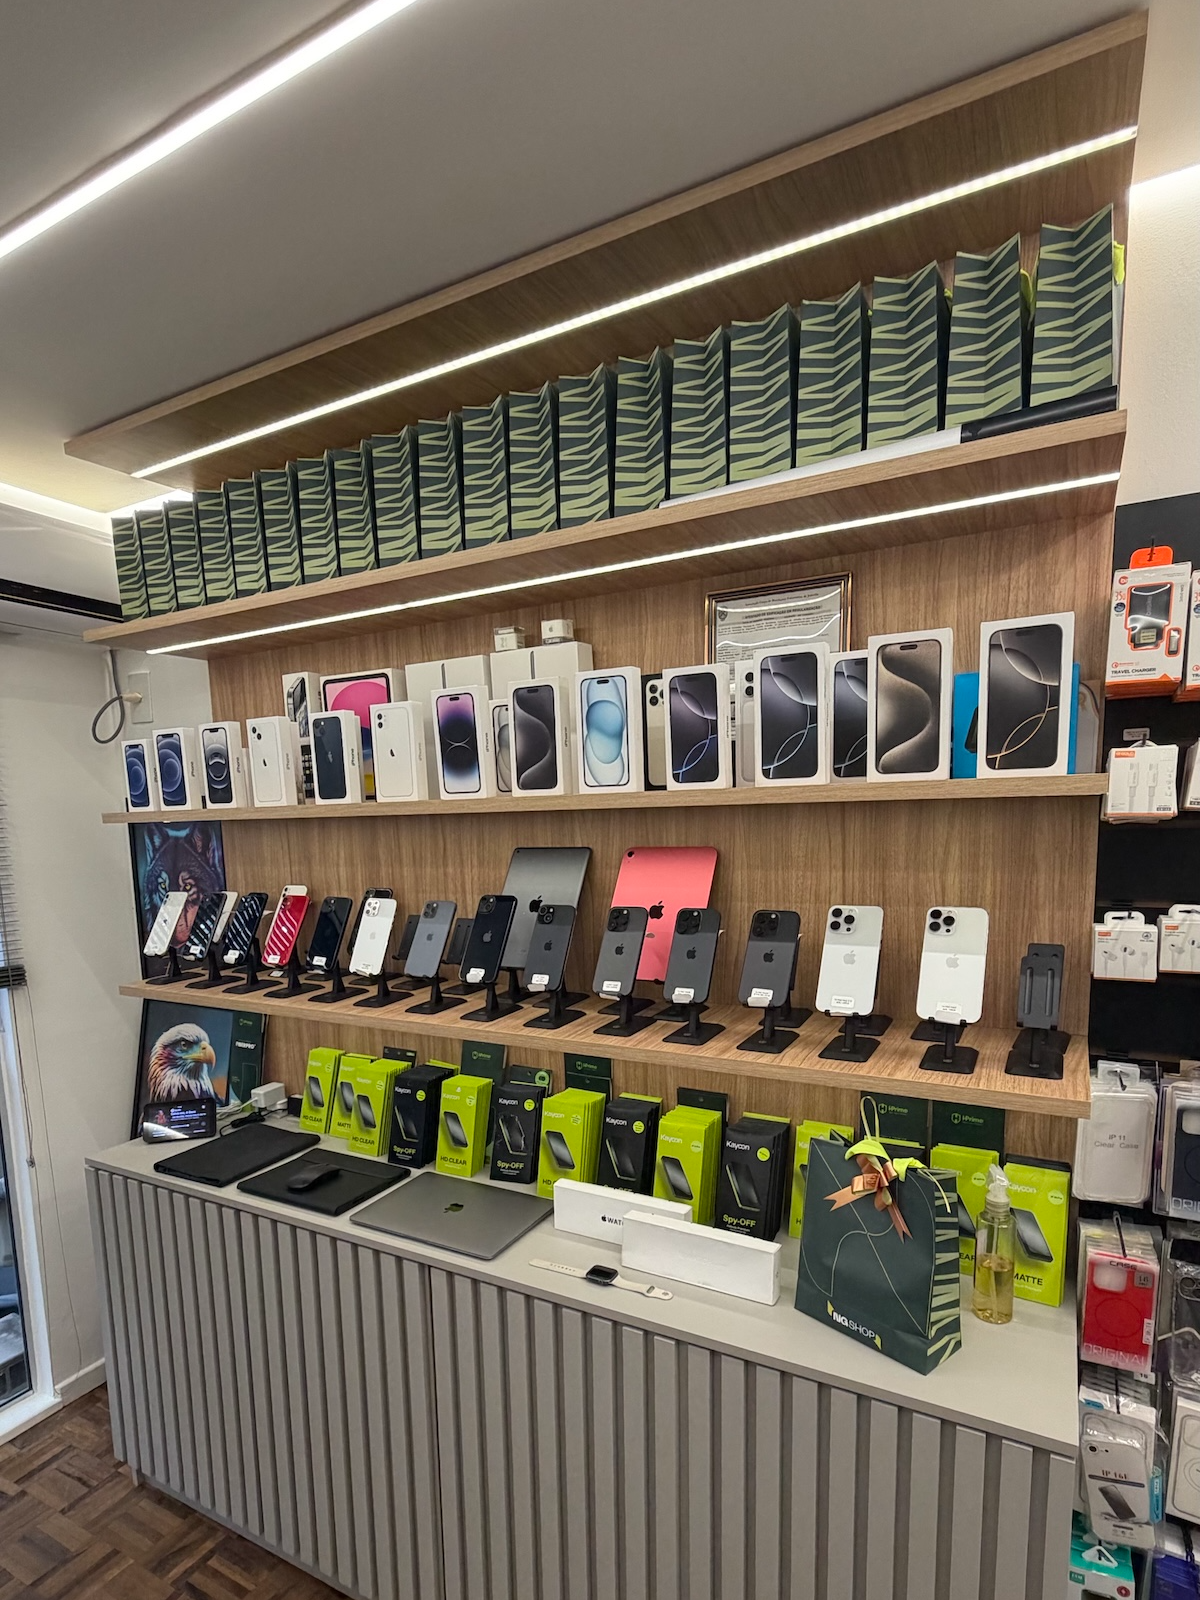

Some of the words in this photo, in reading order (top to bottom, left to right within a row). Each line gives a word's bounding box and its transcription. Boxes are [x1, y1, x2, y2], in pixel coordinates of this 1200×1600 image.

[605, 1116, 628, 1126] Kaycon
[359, 1137, 375, 1146] CLEAR
[660, 1133, 683, 1144] Kaycon
[393, 1144, 416, 1155] Spy-OFF
[726, 1140, 750, 1151] Kaycon
[1094, 1140, 1115, 1149] Clear
[440, 1155, 448, 1163] HD
[448, 1156, 467, 1166] CLEAR
[497, 1159, 525, 1170] Spy-OFF
[542, 1178, 552, 1186] HD
[607, 1216, 623, 1226] WAT
[722, 1213, 757, 1229] Spy-OFF
[1083, 1342, 1145, 1365] ORIGINAL
